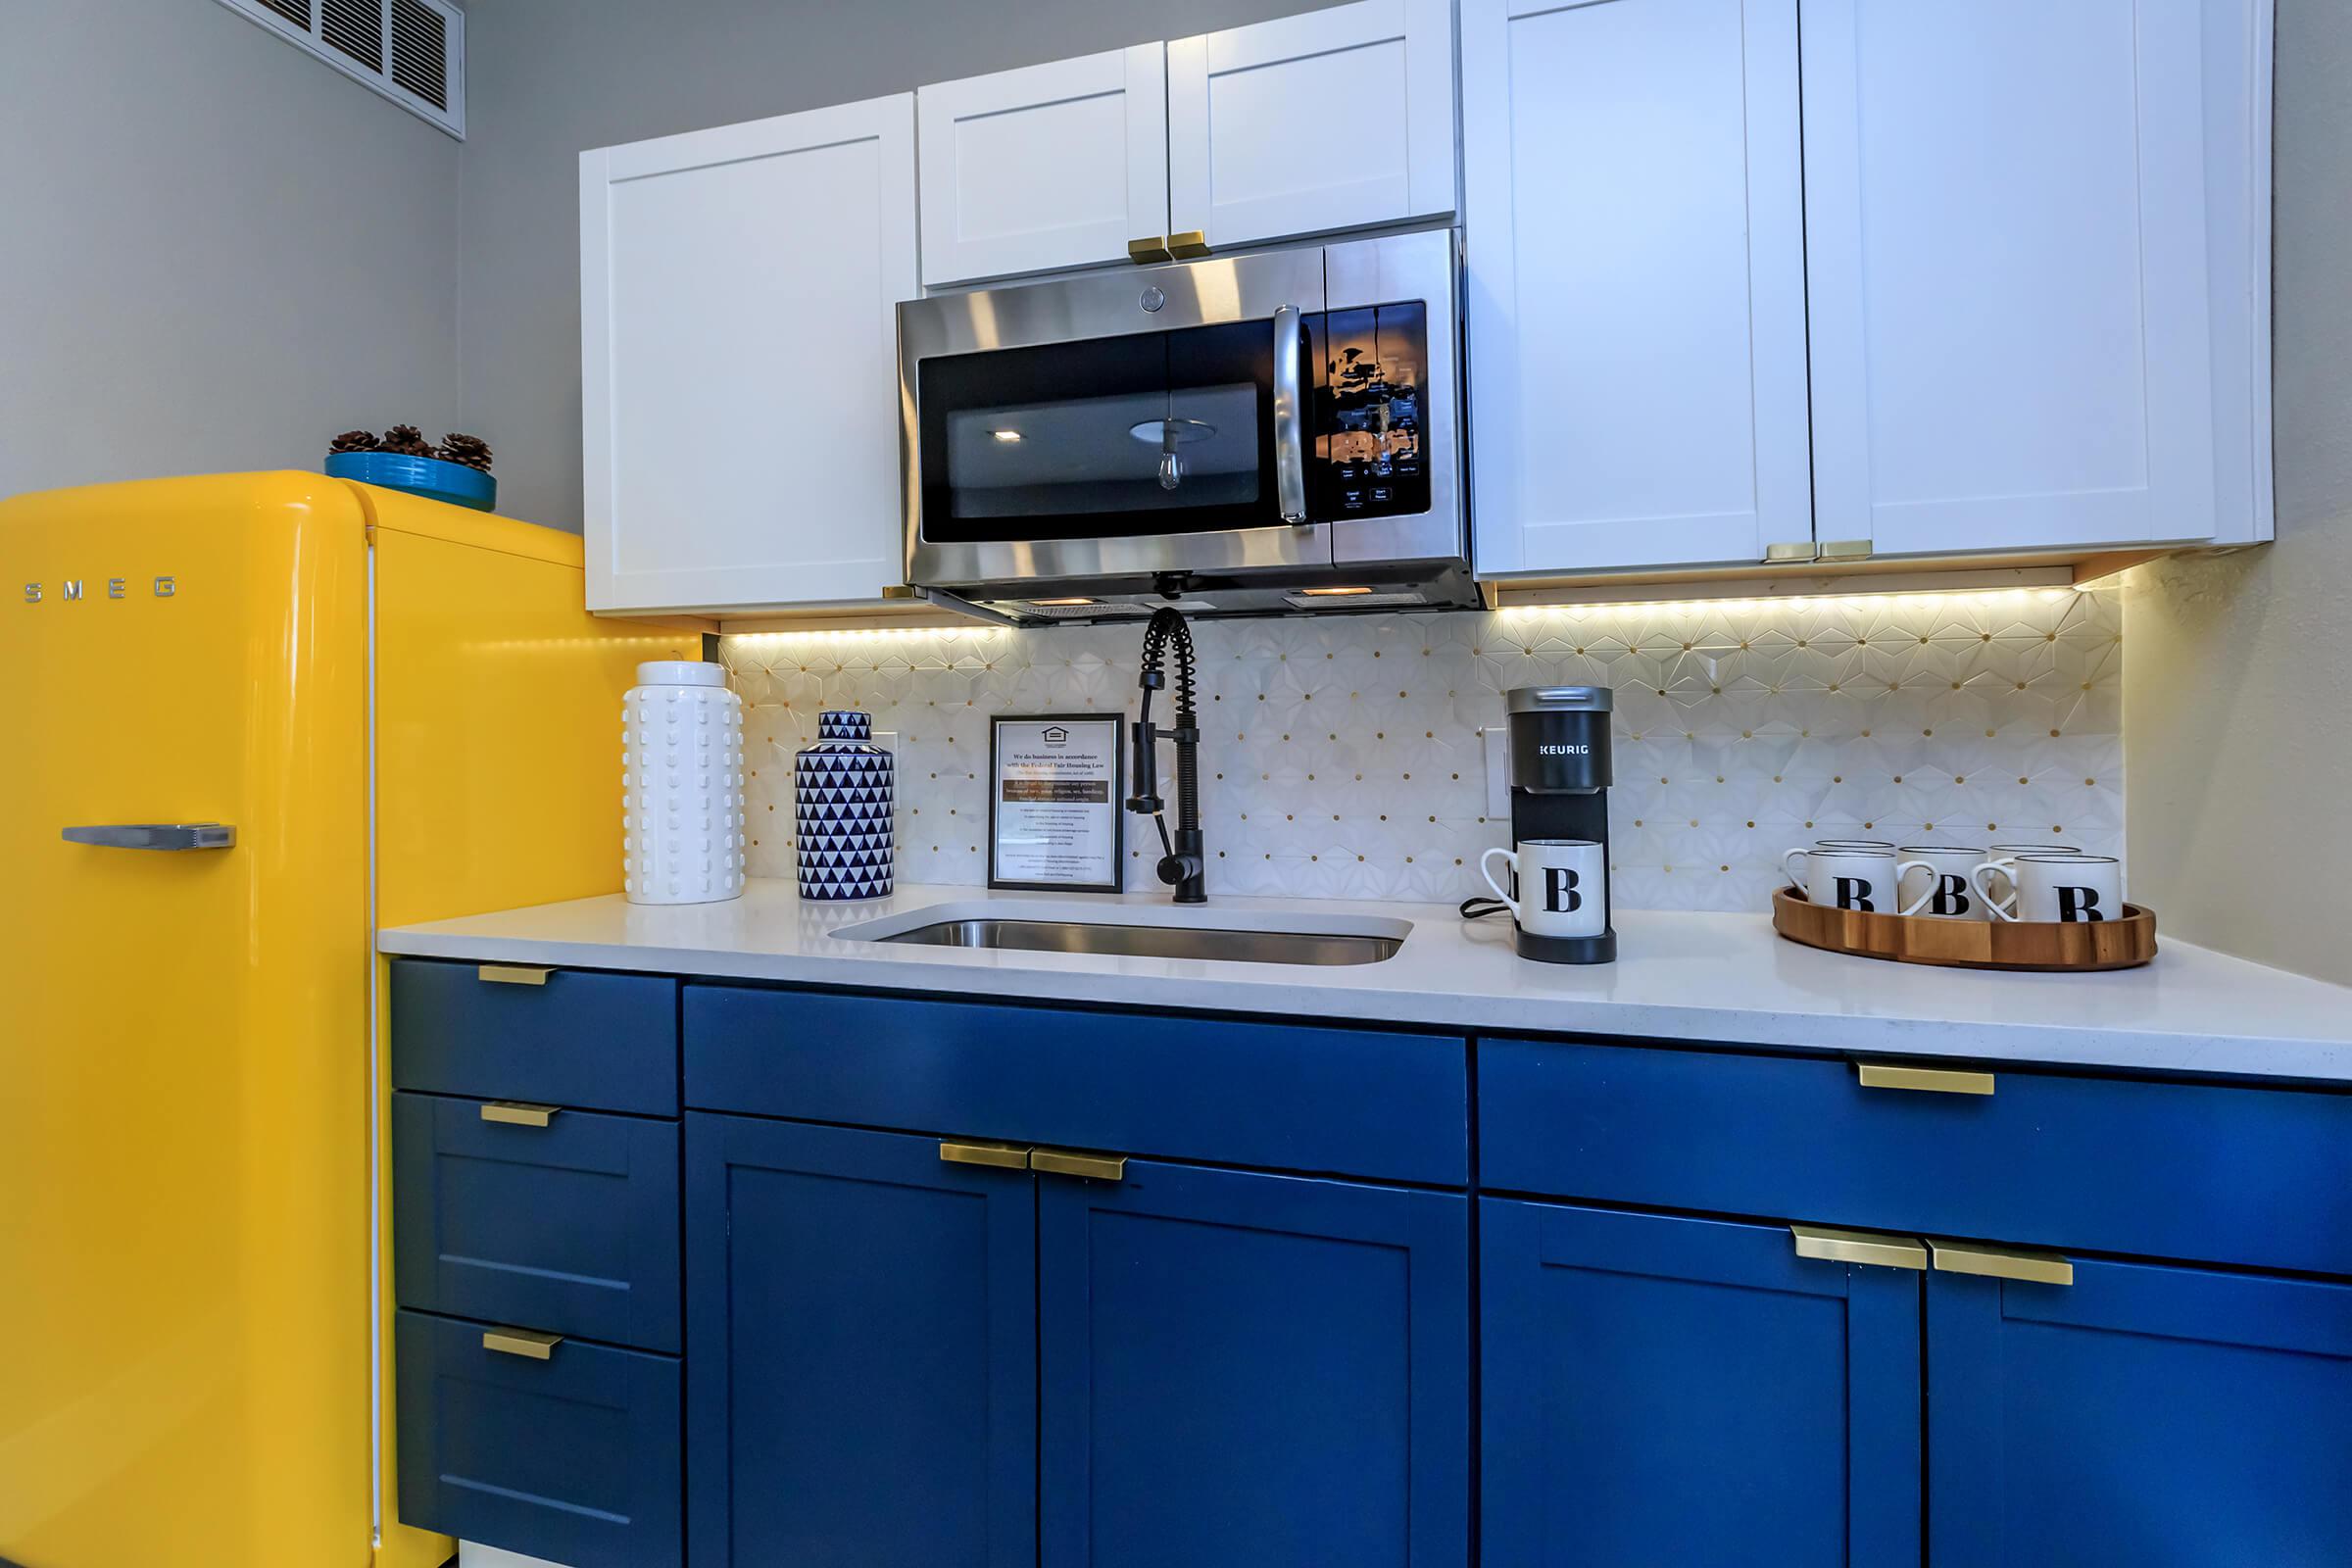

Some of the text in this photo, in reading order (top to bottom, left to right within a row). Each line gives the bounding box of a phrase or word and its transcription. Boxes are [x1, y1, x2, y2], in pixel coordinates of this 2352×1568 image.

[24, 576, 176, 604] SMEG
[1540, 745, 1589, 755] KEURIG
[1542, 867, 1582, 912] B
[1927, 872, 1970, 916] B
